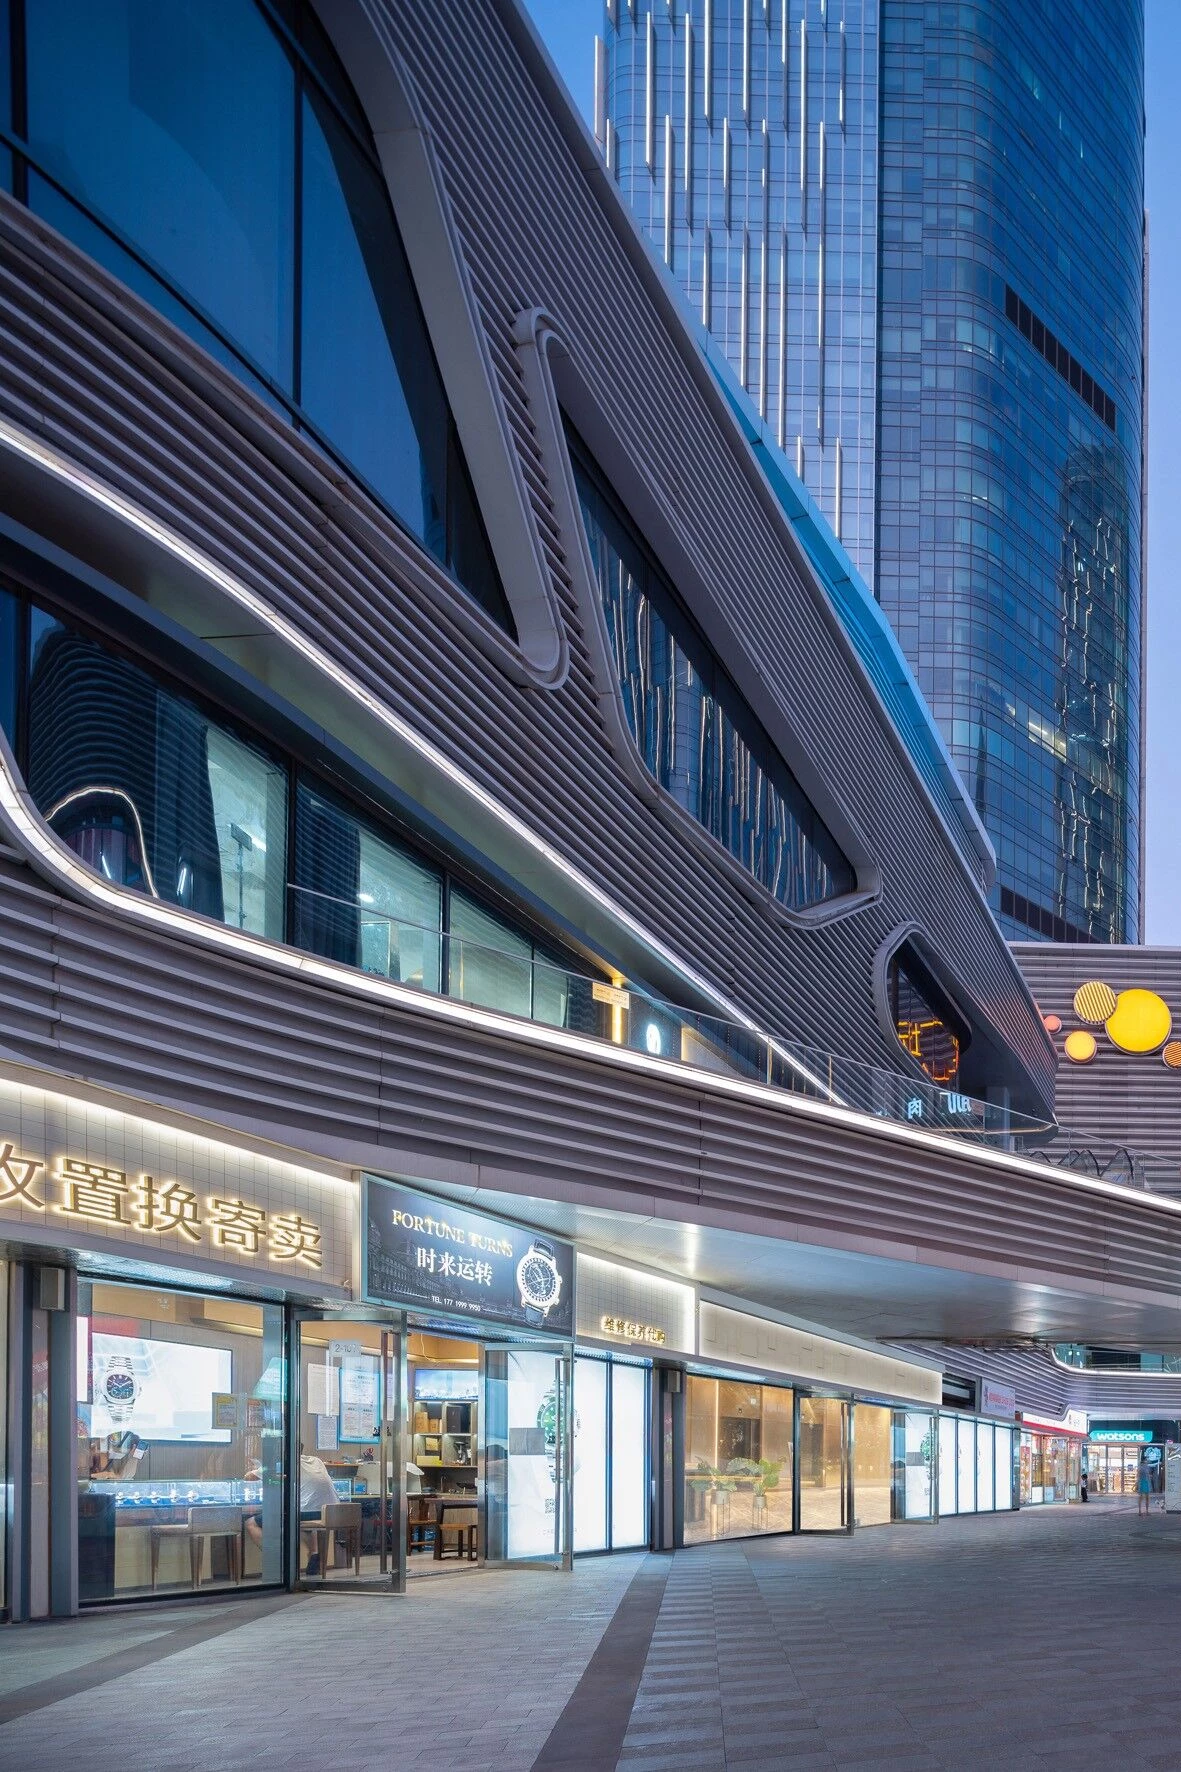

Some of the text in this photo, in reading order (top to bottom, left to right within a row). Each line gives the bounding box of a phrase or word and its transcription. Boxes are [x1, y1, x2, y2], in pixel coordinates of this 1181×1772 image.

[392, 1209, 513, 1258] FORTUNE TURNS
[415, 1247, 493, 1286] 时来运转
[1096, 1432, 1145, 1441] watsons
